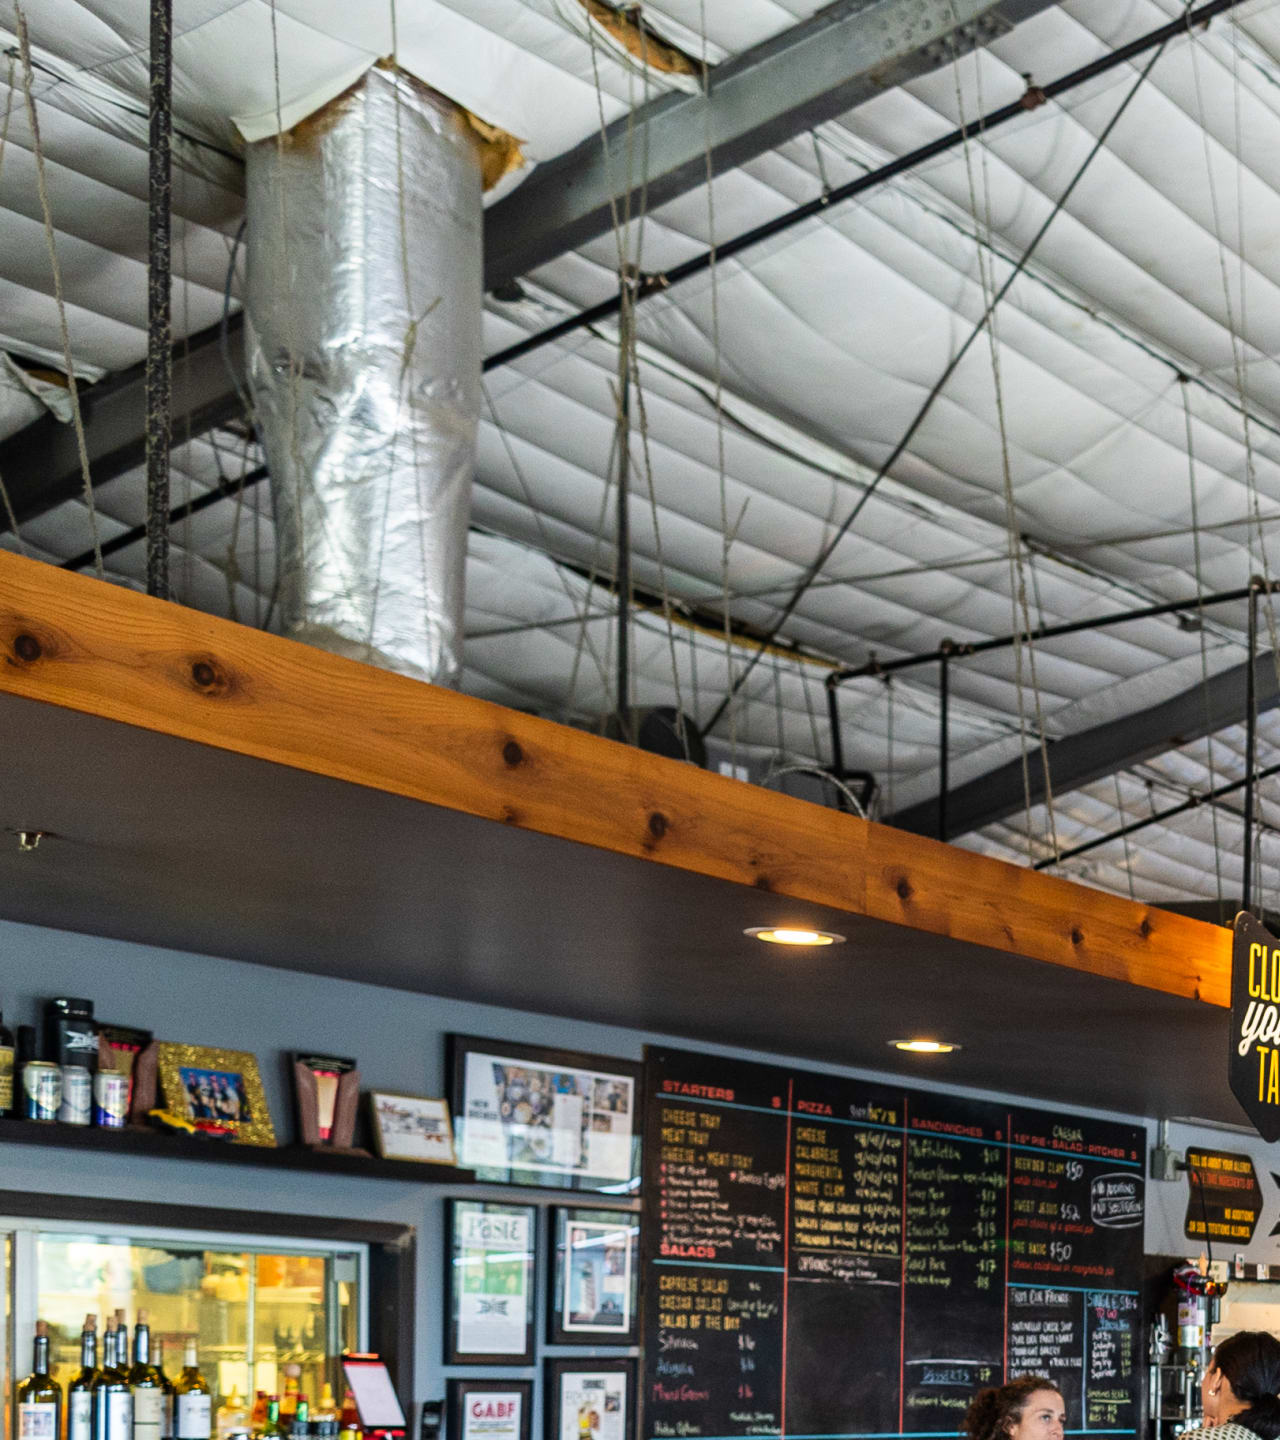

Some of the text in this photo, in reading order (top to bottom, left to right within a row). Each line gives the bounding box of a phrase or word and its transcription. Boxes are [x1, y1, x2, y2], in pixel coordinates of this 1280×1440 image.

[663, 1080, 735, 1101] STARTERS
[797, 1100, 833, 1115] PIZZA
[911, 1117, 984, 1138] SANDWICHES
[1031, 1136, 1046, 1147] PIE
[1052, 1140, 1083, 1153] SALAD
[1089, 1144, 1126, 1158] PITCHER
[1065, 1160, 1084, 1181] $50
[1060, 1202, 1081, 1221] $52
[660, 1244, 717, 1258] SALADS
[1050, 1241, 1073, 1262] $50
[701, 1278, 730, 1294] SALAD
[694, 1296, 723, 1312] SALAD
[658, 1313, 741, 1331] SALAD OF THE DAY
[471, 1400, 516, 1419] GABF
